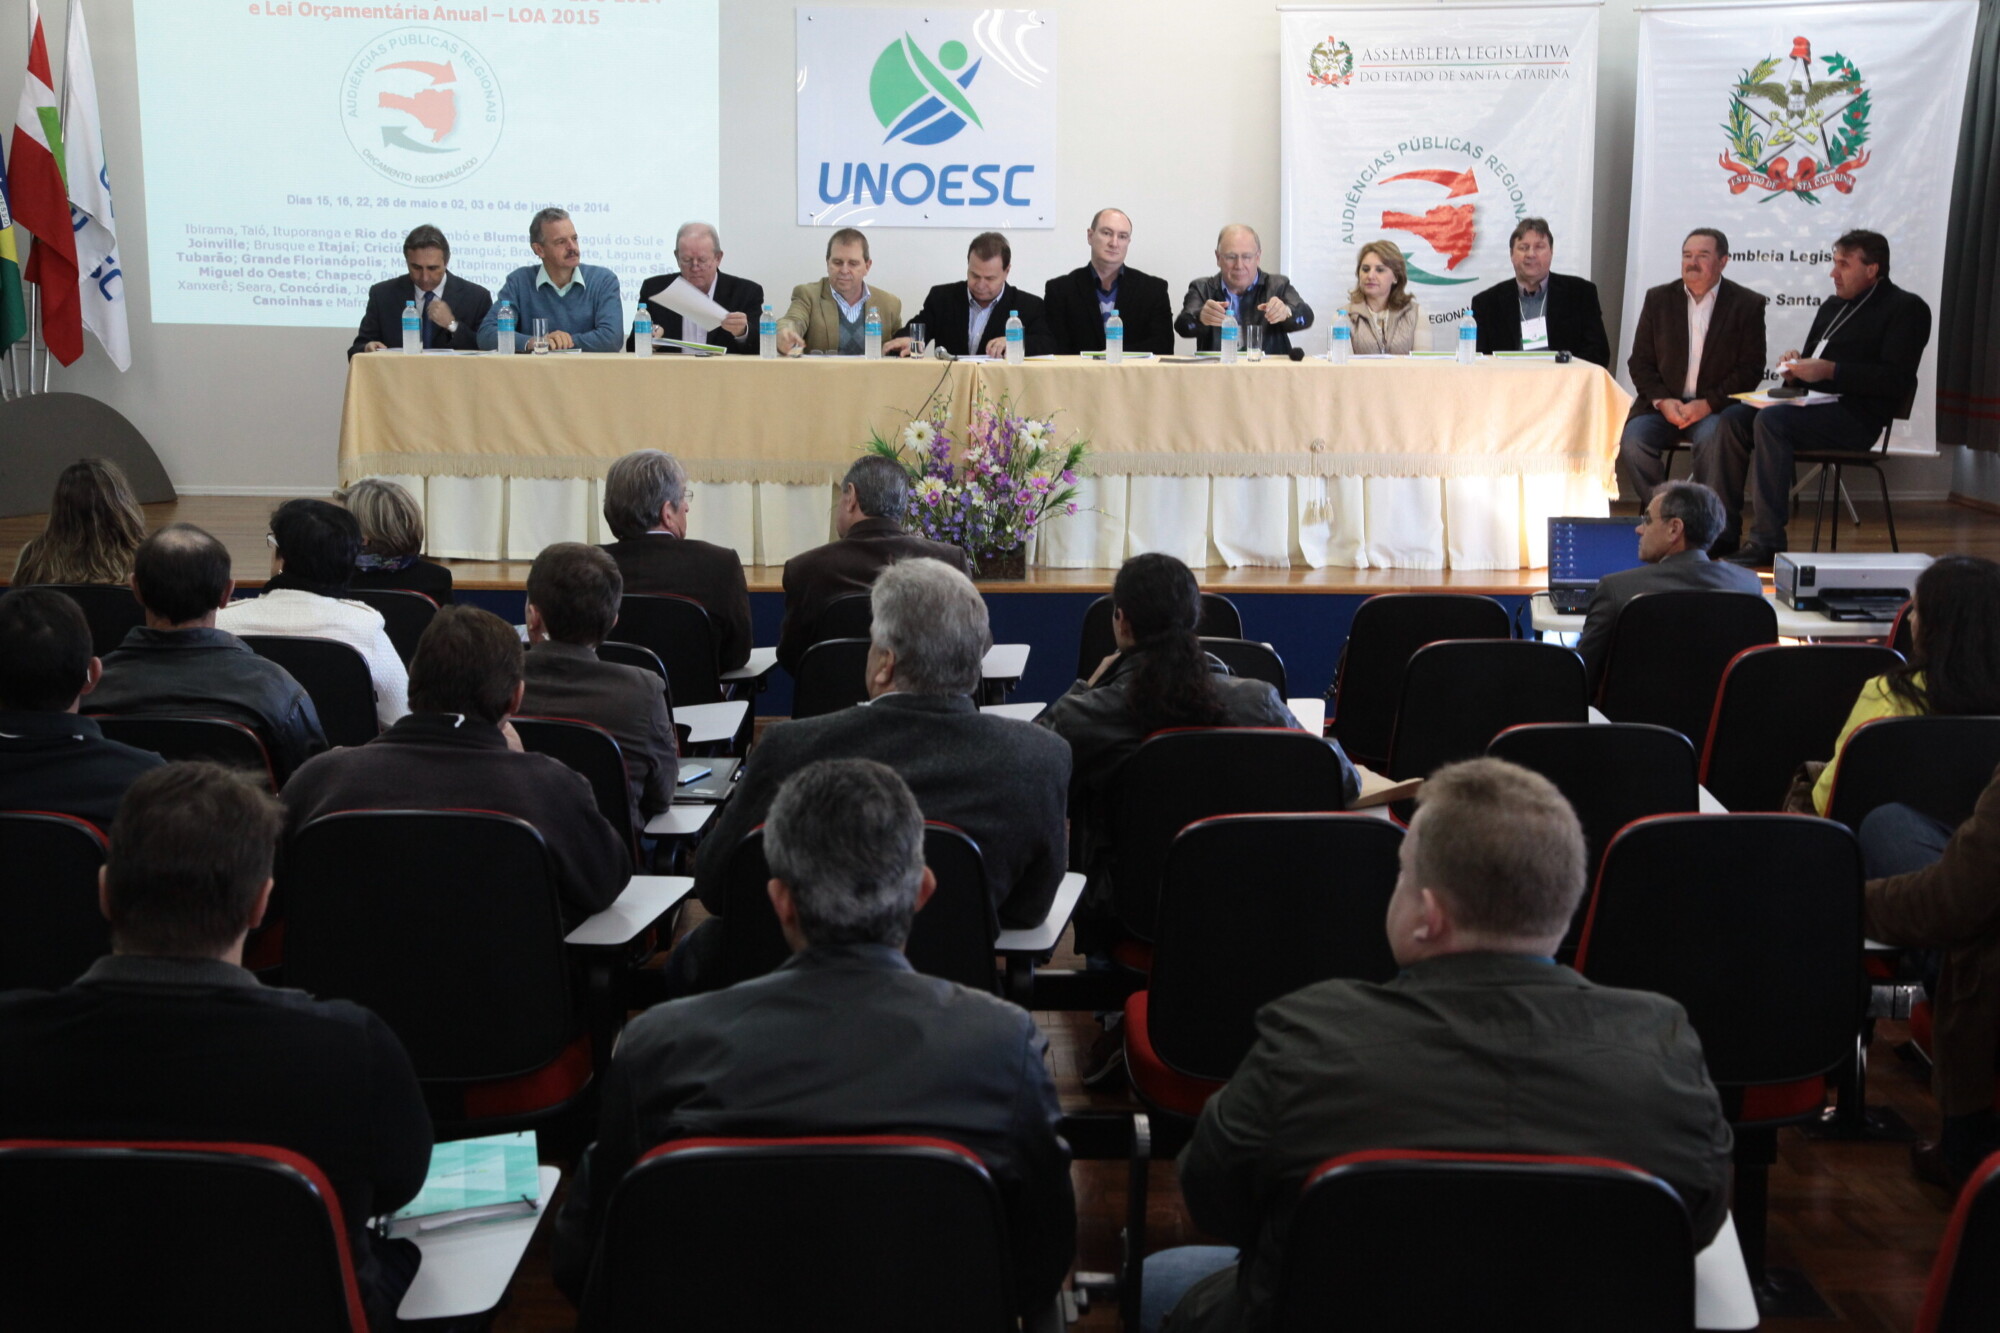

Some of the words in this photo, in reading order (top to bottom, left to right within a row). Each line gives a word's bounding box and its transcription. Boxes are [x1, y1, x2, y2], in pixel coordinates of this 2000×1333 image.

[249, 3, 260, 15] e
[265, 1, 293, 16] Lei
[298, 1, 430, 21] Orçamentária
[433, 5, 488, 22] Anual
[508, 7, 547, 23] LOA
[551, 8, 600, 25] 2015
[1362, 47, 1461, 62] ASSEMBLEIA
[1467, 44, 1570, 60] LEGISLATIVA
[1359, 71, 1381, 82] DO
[1384, 70, 1434, 82] ESTADO
[1438, 70, 1456, 81] DE
[1459, 69, 1501, 81] SANTA
[1504, 67, 1570, 80] CATARINA
[460, 50, 497, 123] REGIONAIS
[414, 156, 479, 184] REGIONALIZADO
[818, 162, 1035, 207] UNOESC
[1731, 173, 1765, 186] ESTADO
[1813, 172, 1854, 188] CATARINA
[1341, 150, 1395, 245] AUDIÊNCIAS
[1397, 135, 1484, 160] PÚBLICAS
[287, 195, 313, 206] Dias
[317, 196, 333, 208] 15,
[337, 196, 353, 208] 16,
[356, 196, 373, 209] 22,
[376, 197, 390, 208] 26
[393, 198, 407, 208] de
[410, 198, 439, 209] maio
[451, 200, 468, 212] 02,
[471, 200, 485, 210] 03
[487, 202, 495, 210] e
[497, 200, 512, 210] 04
[514, 201, 528, 211] de
[566, 202, 581, 212] de
[583, 202, 610, 212] 2014
[185, 224, 238, 237] Ibirama,
[272, 225, 342, 240] Ituporanga
[343, 230, 352, 239] e
[354, 228, 377, 239] Rio
[380, 229, 397, 240] do
[472, 233, 481, 242] e
[614, 235, 630, 246] do
[632, 236, 653, 247] Sul
[655, 238, 664, 247] e
[187, 238, 250, 251] Joinville;
[253, 239, 305, 252] Brusque
[307, 242, 315, 251] e
[606, 250, 652, 262] Laguna
[653, 252, 662, 261] e
[176, 252, 238, 265] Tubarão;
[241, 253, 291, 265] Grande
[293, 255, 387, 268] Florianópolis;
[639, 266, 647, 274] e
[199, 266, 244, 280] Miguel
[247, 268, 264, 279] do
[267, 268, 311, 281] Oeste;
[315, 269, 376, 283] Chapecó,
[177, 279, 233, 292] Xanxerê;
[236, 281, 276, 294] Seara,
[279, 281, 351, 296] Concórdia,
[252, 295, 323, 307] Canoinhas
[325, 299, 333, 307] e
[1776, 293, 1821, 306] Santa
